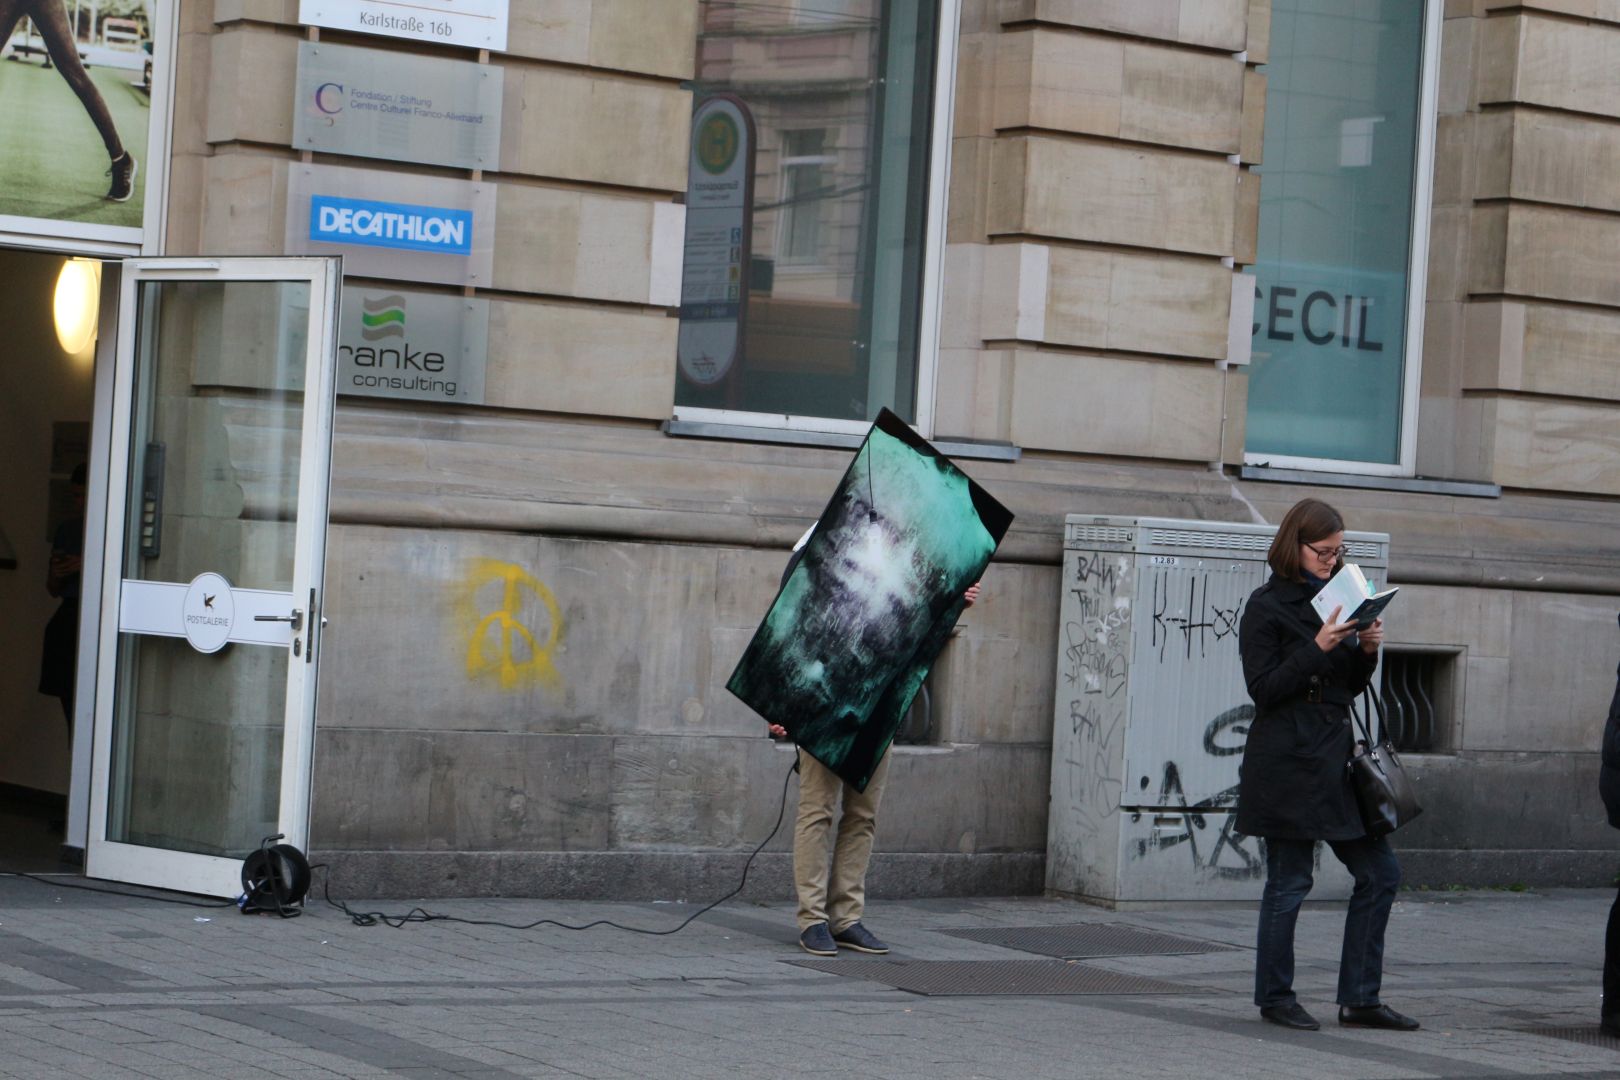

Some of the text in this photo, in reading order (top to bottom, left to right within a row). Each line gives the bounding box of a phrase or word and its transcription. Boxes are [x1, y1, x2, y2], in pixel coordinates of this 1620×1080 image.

[359, 11, 453, 37] Karlstraße 16b
[350, 87, 394, 104] Fondation
[399, 93, 433, 109] Stiftung
[350, 99, 378, 112] Centre
[379, 102, 412, 116] Culturel
[319, 206, 465, 246] DECATHLON
[1252, 285, 1383, 351] ECIL
[352, 374, 457, 396] consulting
[186, 614, 229, 627] POSTGALERIE
